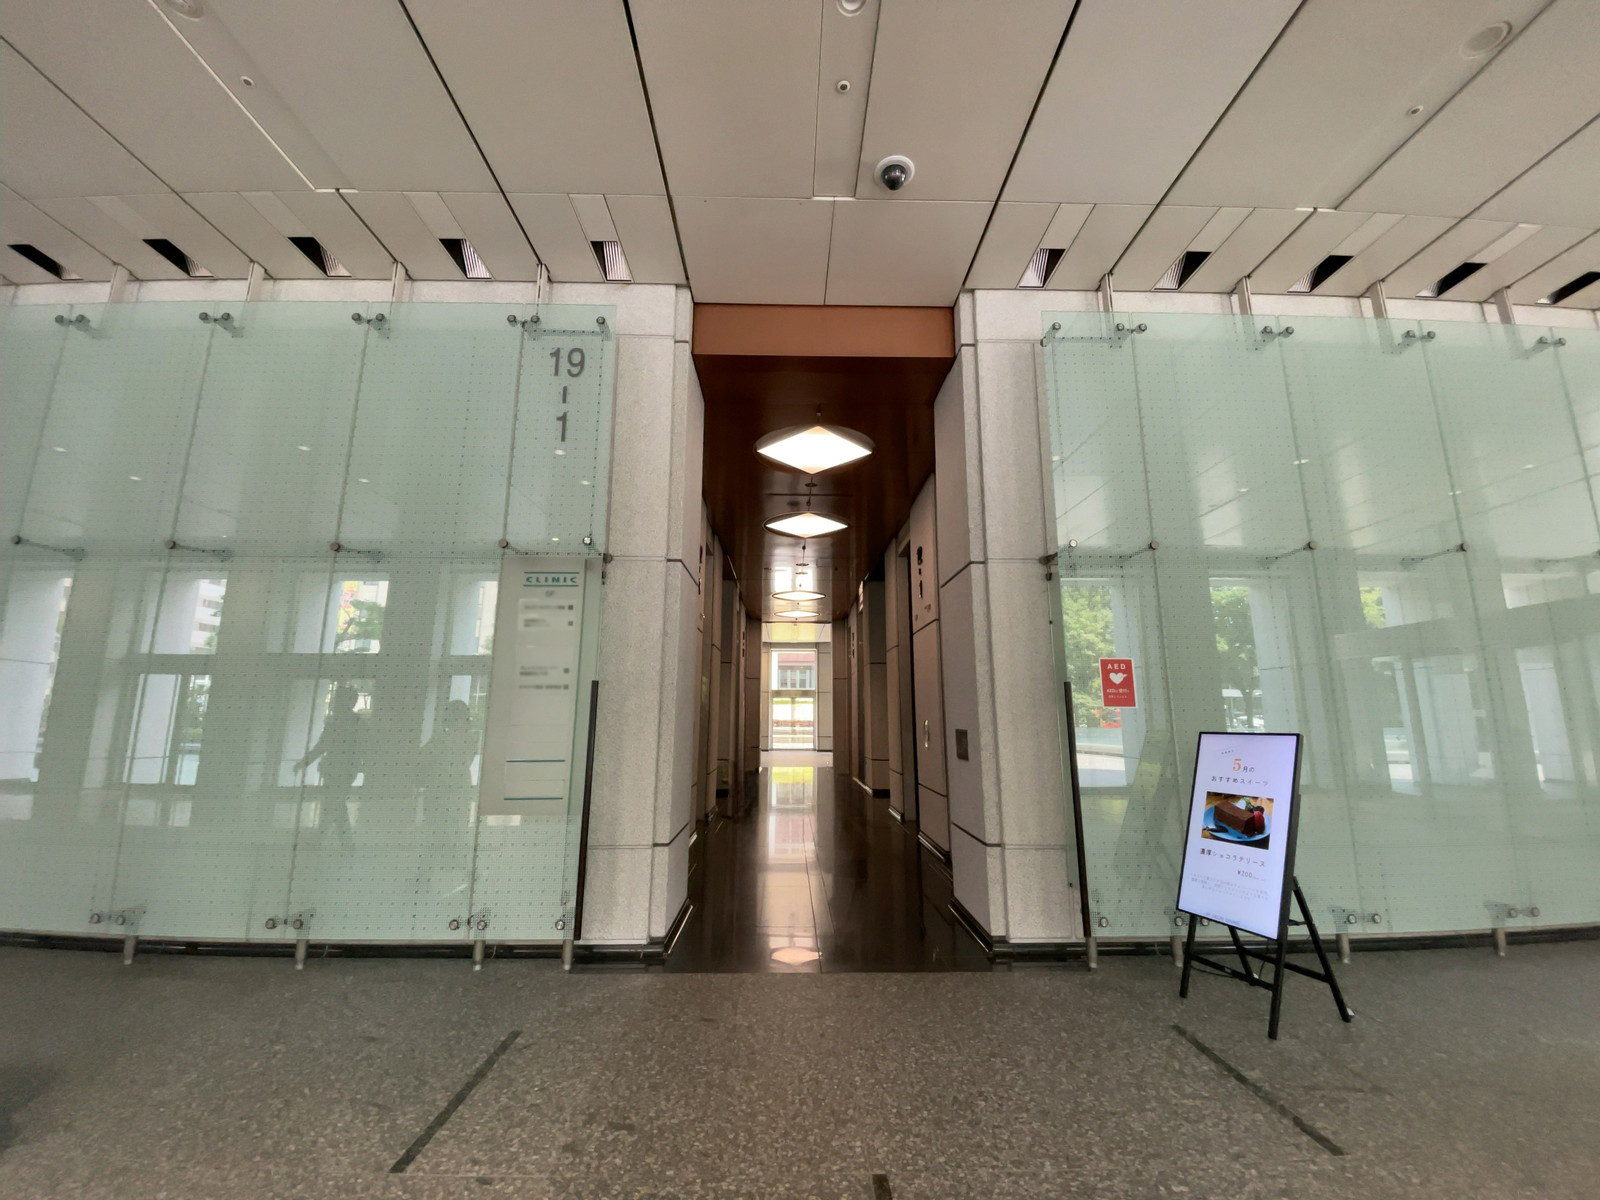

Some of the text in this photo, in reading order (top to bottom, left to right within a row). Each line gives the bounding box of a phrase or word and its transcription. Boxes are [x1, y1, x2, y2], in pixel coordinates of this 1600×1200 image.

[1232, 758, 1255, 773] 5月の
[1211, 775, 1269, 787] おすすめスイーツ
